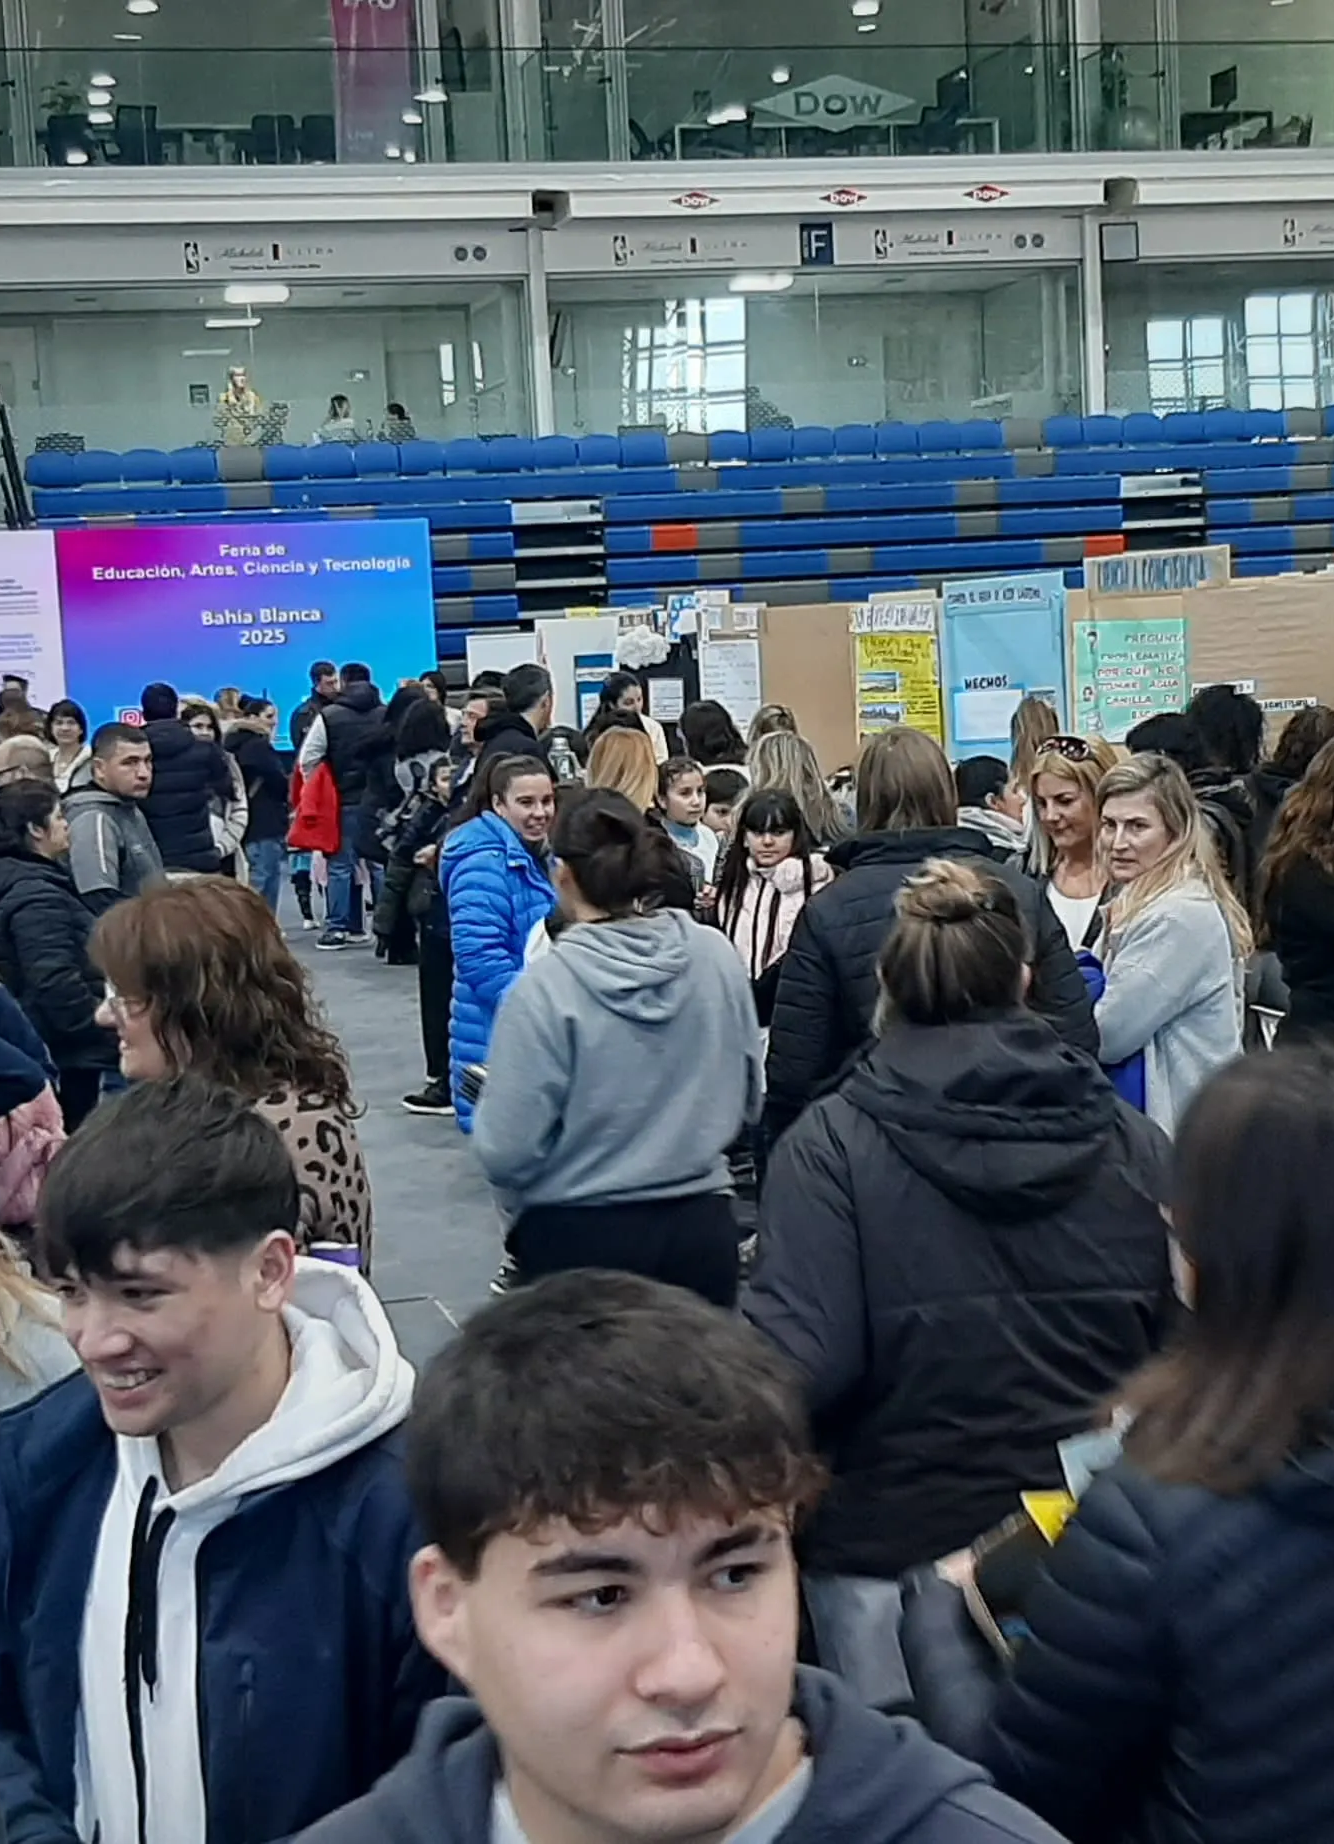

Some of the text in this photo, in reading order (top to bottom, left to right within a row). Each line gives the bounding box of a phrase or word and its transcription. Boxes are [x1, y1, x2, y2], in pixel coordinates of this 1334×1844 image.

[810, 229, 828, 259] F
[219, 543, 286, 558] Feria de
[92, 555, 412, 582] Educación, Artes, Ciencia y Tecnología
[200, 607, 322, 626] Bahía Blanca
[239, 628, 287, 646] 2025
[964, 674, 1008, 690] HECHOS
